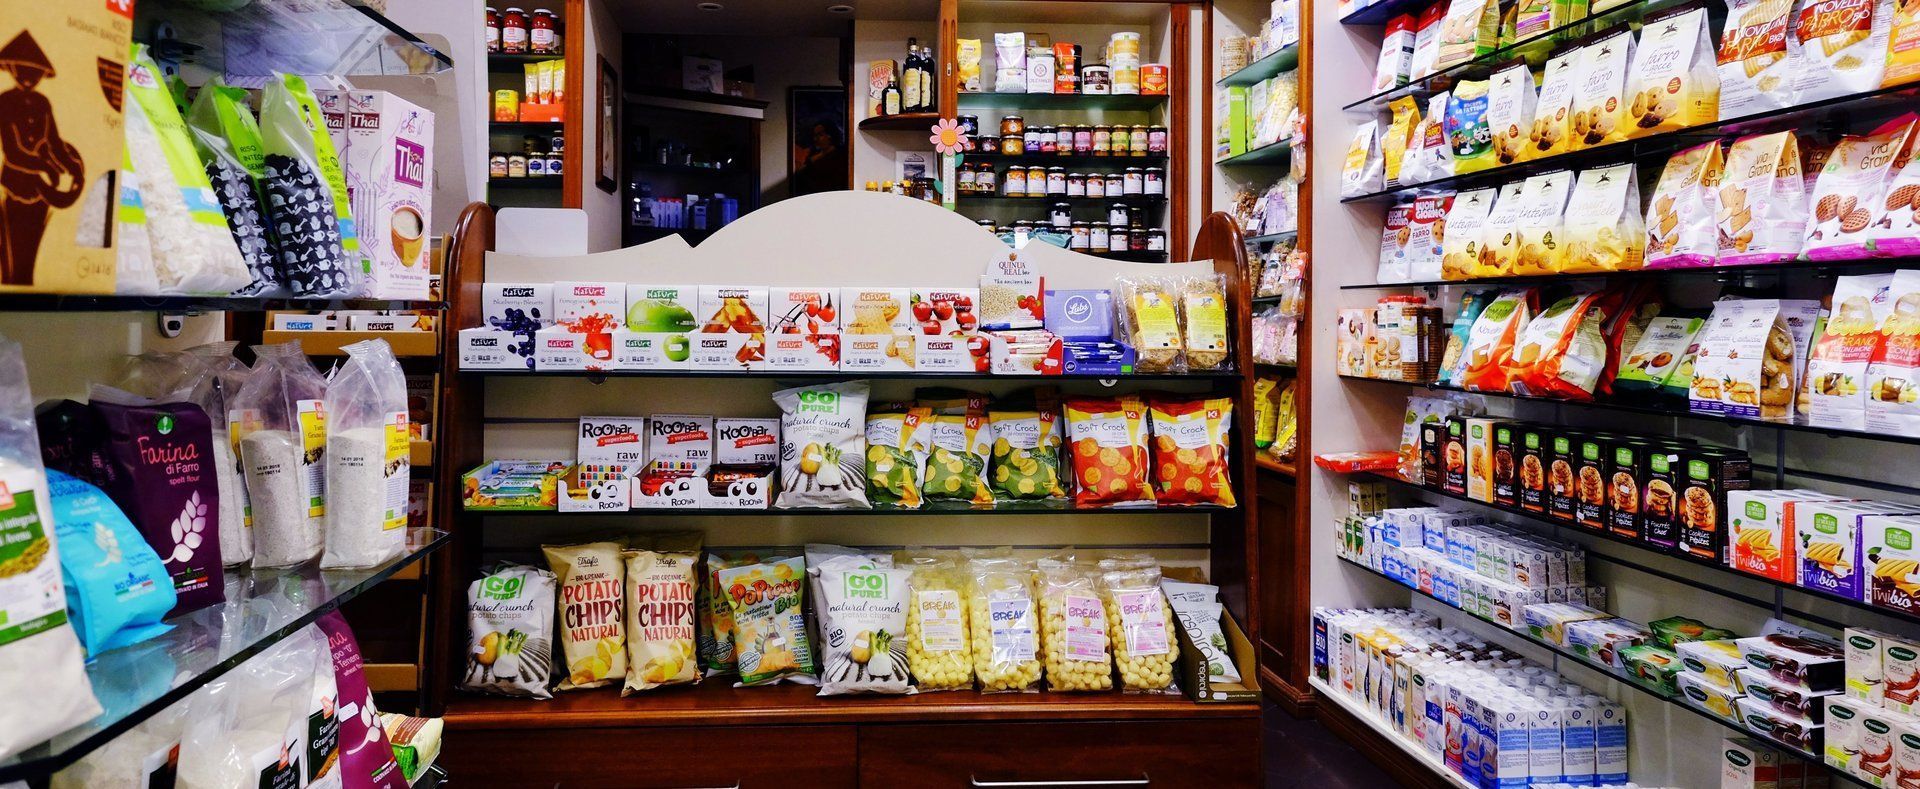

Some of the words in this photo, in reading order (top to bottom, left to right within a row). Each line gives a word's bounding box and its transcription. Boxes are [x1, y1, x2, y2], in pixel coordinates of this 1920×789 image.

[1802, 8, 1853, 32] FARRO
[1724, 33, 1770, 55] FARRO
[351, 114, 379, 128] Thai
[1870, 143, 1889, 156] via
[397, 144, 424, 183] Thai
[1756, 152, 1769, 166] via
[1415, 200, 1435, 210] BUON
[1415, 208, 1446, 219] GIORNO
[1412, 229, 1430, 239] FARRO
[801, 390, 833, 404] GO
[801, 404, 834, 413] PURE
[783, 414, 818, 428] natural
[819, 418, 851, 429] crunch
[1014, 423, 1039, 432] Crock
[1102, 422, 1126, 432] Crock
[793, 426, 817, 434] potato
[819, 425, 840, 435] chips
[876, 424, 899, 435] Crock
[941, 426, 964, 436] Crock
[1180, 425, 1205, 435] Crock
[137, 436, 199, 465] Farina
[616, 451, 639, 460] raw
[687, 449, 708, 457] raw
[754, 453, 776, 461] raw
[166, 463, 175, 475] di
[175, 462, 199, 473] Farro
[169, 476, 186, 486] spelt
[186, 475, 200, 483] flour
[1688, 529, 1710, 539] Cookies
[114, 580, 125, 590] BIO
[126, 574, 151, 588] ORGANIC
[486, 575, 520, 591] GO
[850, 574, 883, 591] GO
[485, 589, 519, 600] PURE
[563, 579, 621, 604] POTATO
[638, 581, 693, 603] POTATO
[850, 589, 883, 599] PURE
[499, 600, 534, 612] crunch
[773, 595, 799, 615] Bio
[829, 601, 868, 614] natural
[869, 604, 902, 614] crunch
[922, 601, 954, 611] BREAK
[1123, 604, 1157, 615] BREAK
[472, 612, 497, 620] potato
[499, 611, 522, 620] chips
[565, 599, 622, 629] CHIPS
[638, 602, 694, 628] CHIPS
[842, 612, 865, 620] potato
[868, 611, 891, 620] chips
[992, 610, 1025, 621] BREAK
[1068, 607, 1100, 619] BREAK
[571, 624, 620, 643] NATURAL
[644, 626, 692, 642] NATURAL
[829, 628, 843, 641] BIO
[337, 653, 360, 668] Tenero
